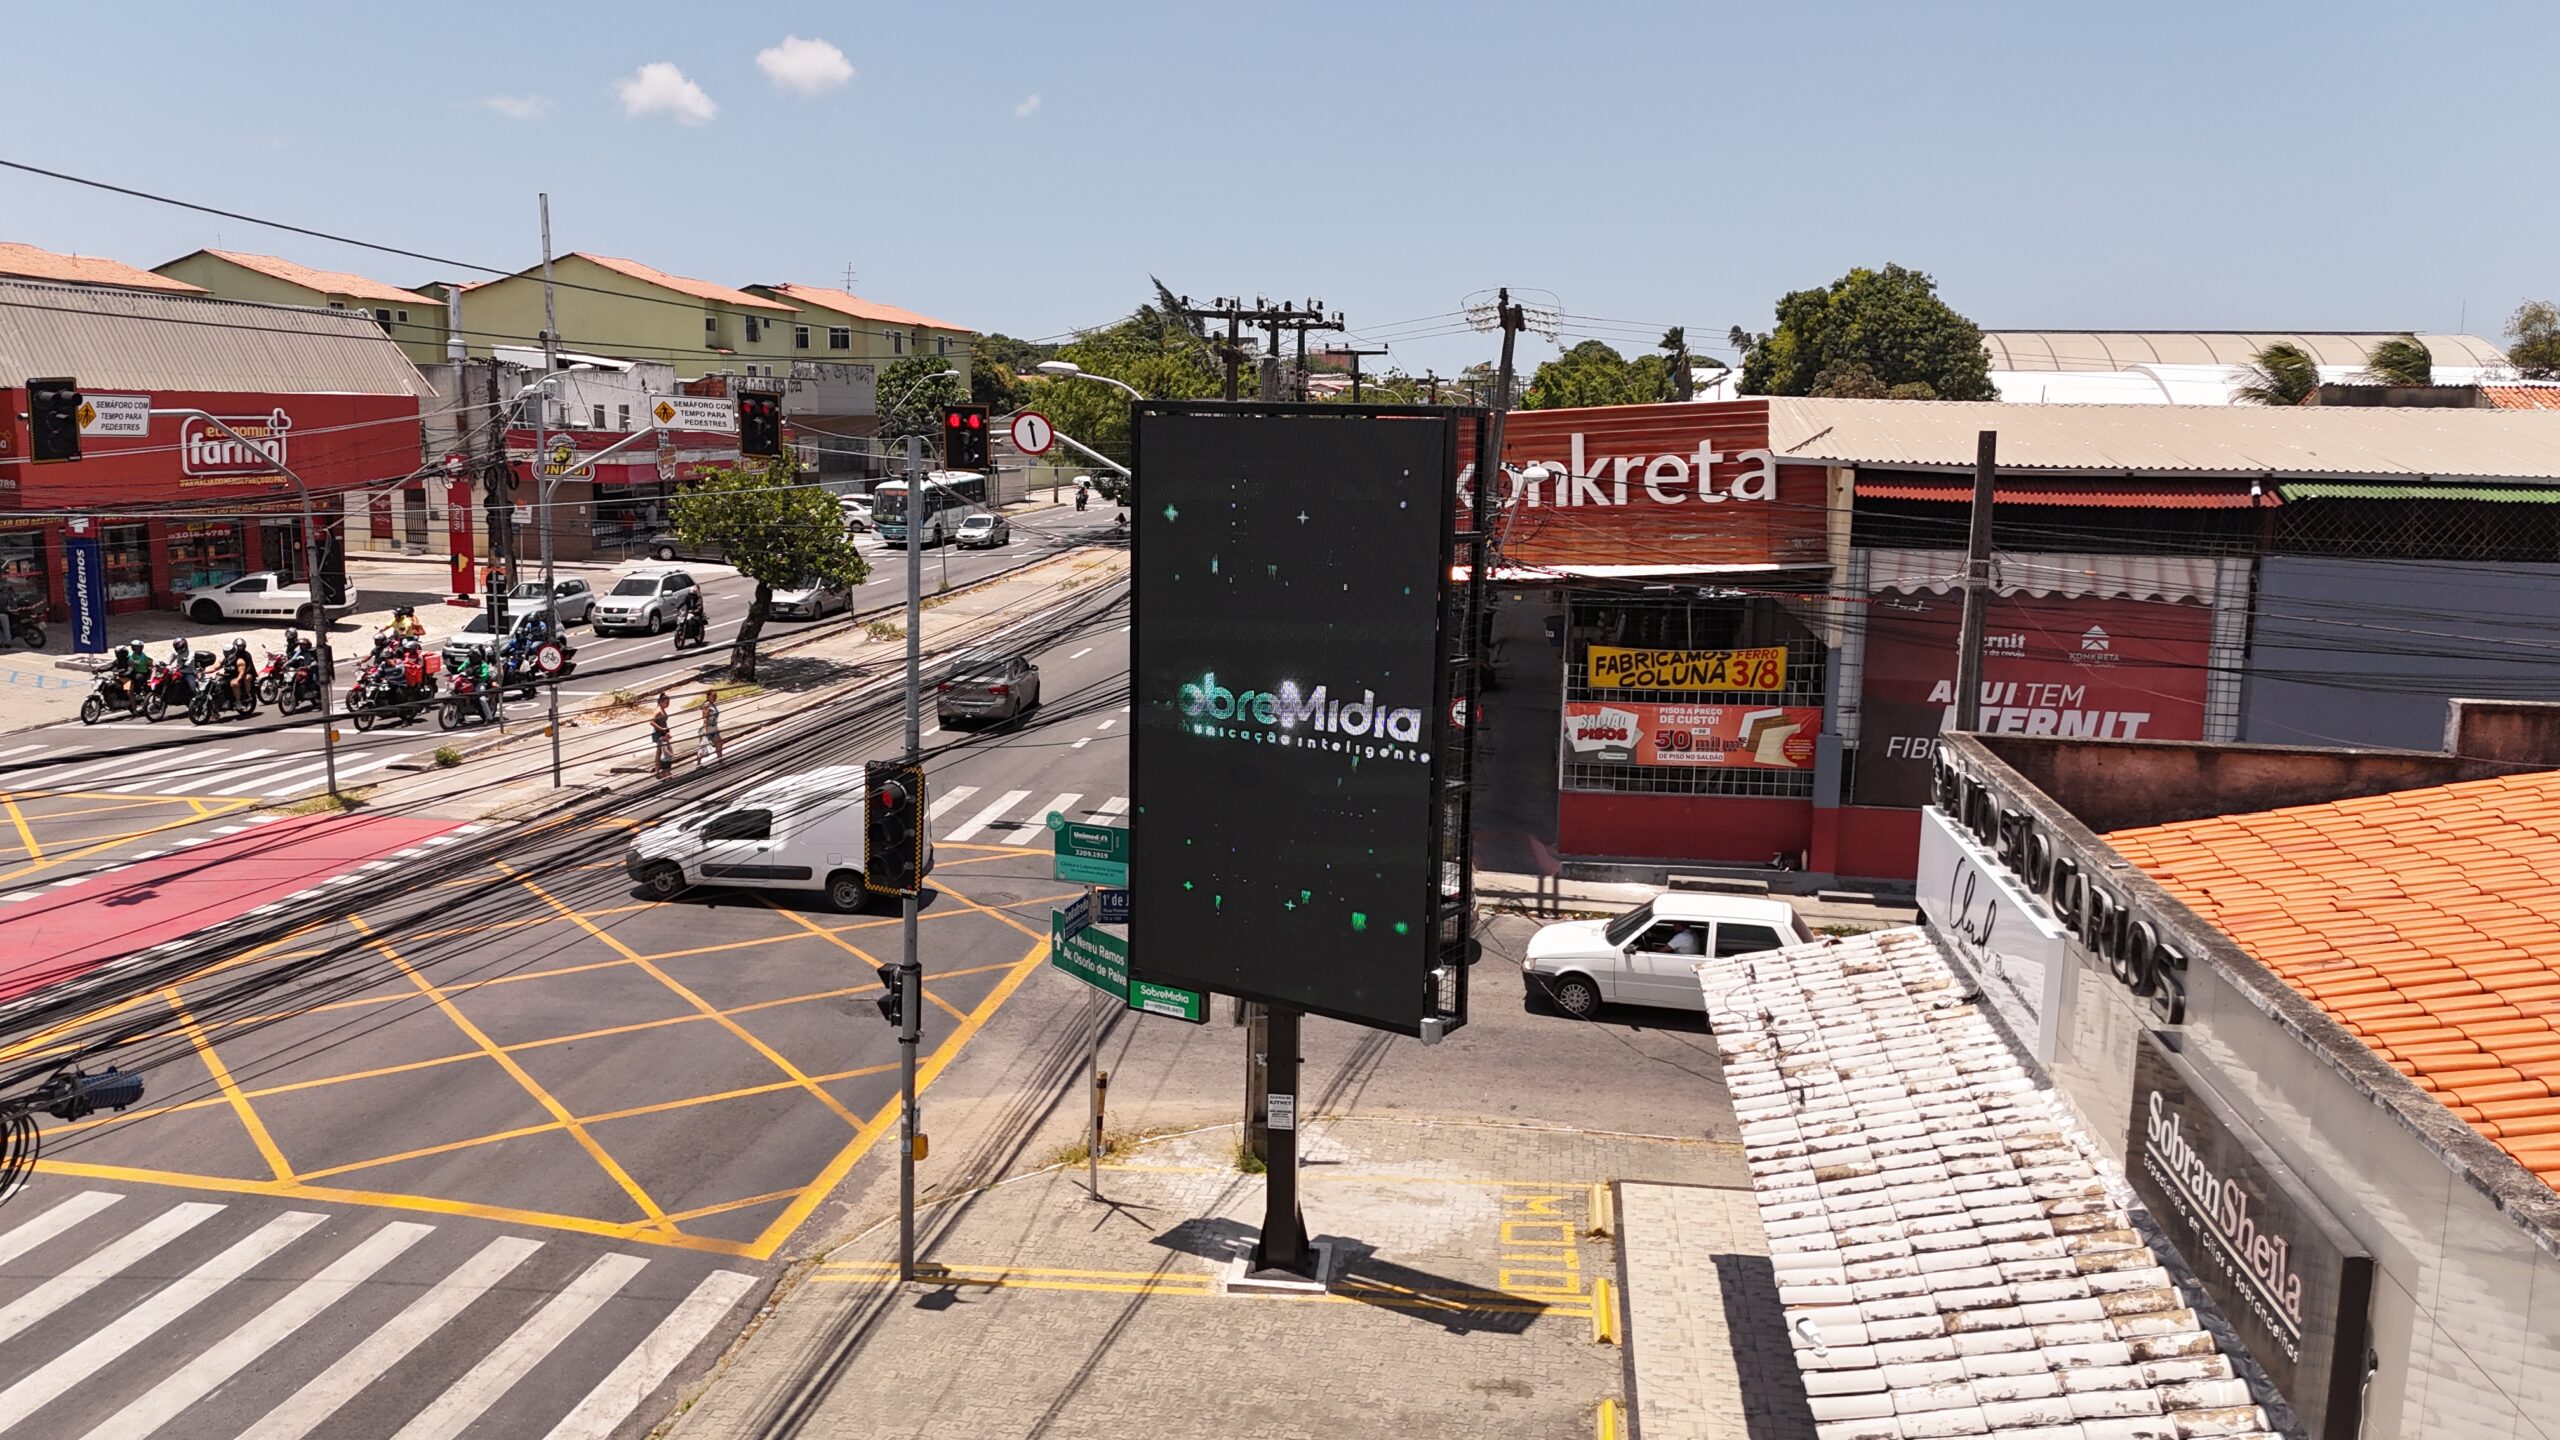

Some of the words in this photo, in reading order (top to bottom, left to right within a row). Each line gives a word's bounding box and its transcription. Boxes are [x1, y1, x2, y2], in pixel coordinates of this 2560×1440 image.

[96, 400, 133, 409] SEMÁFORO
[133, 401, 149, 409] COM
[673, 400, 714, 409] SEMÁFORO
[715, 402, 732, 410] COM
[101, 412, 123, 420] TEMPO
[680, 410, 705, 418] TEMPO
[707, 411, 727, 419] PARA
[100, 423, 140, 431] PEDESTRES
[684, 419, 727, 428] PEDESTRES
[1456, 433, 1776, 508] onkreta
[76, 549, 93, 645] PagueMenos
[1595, 650, 1733, 677] FABRICAMOS
[1736, 650, 1779, 659] FERRO
[2069, 652, 2120, 662] KONKRETA
[1619, 661, 1727, 687] COLUNA
[1731, 659, 1780, 689] 3/8
[1926, 679, 2018, 706] AUI
[2026, 683, 2086, 708] TEM
[1659, 707, 1685, 715] PISOS
[1694, 708, 1723, 717] PREÇO
[1660, 715, 1675, 724] DE
[1676, 715, 1720, 725] CUSTO!
[1577, 727, 1628, 741] PISOS
[1654, 730, 1692, 750] 50
[1111, 893, 1123, 906] de
[1076, 935, 1098, 955] Nereu
[1099, 945, 1125, 966] Ramos
[1096, 963, 1107, 976] de
[1108, 967, 1127, 987] Paiva
[2143, 1152, 2186, 1217] Especialista
[2188, 1216, 2200, 1236] em
[2226, 1265, 2233, 1277] e
[2235, 1273, 2299, 1364] Sobrancelhas
